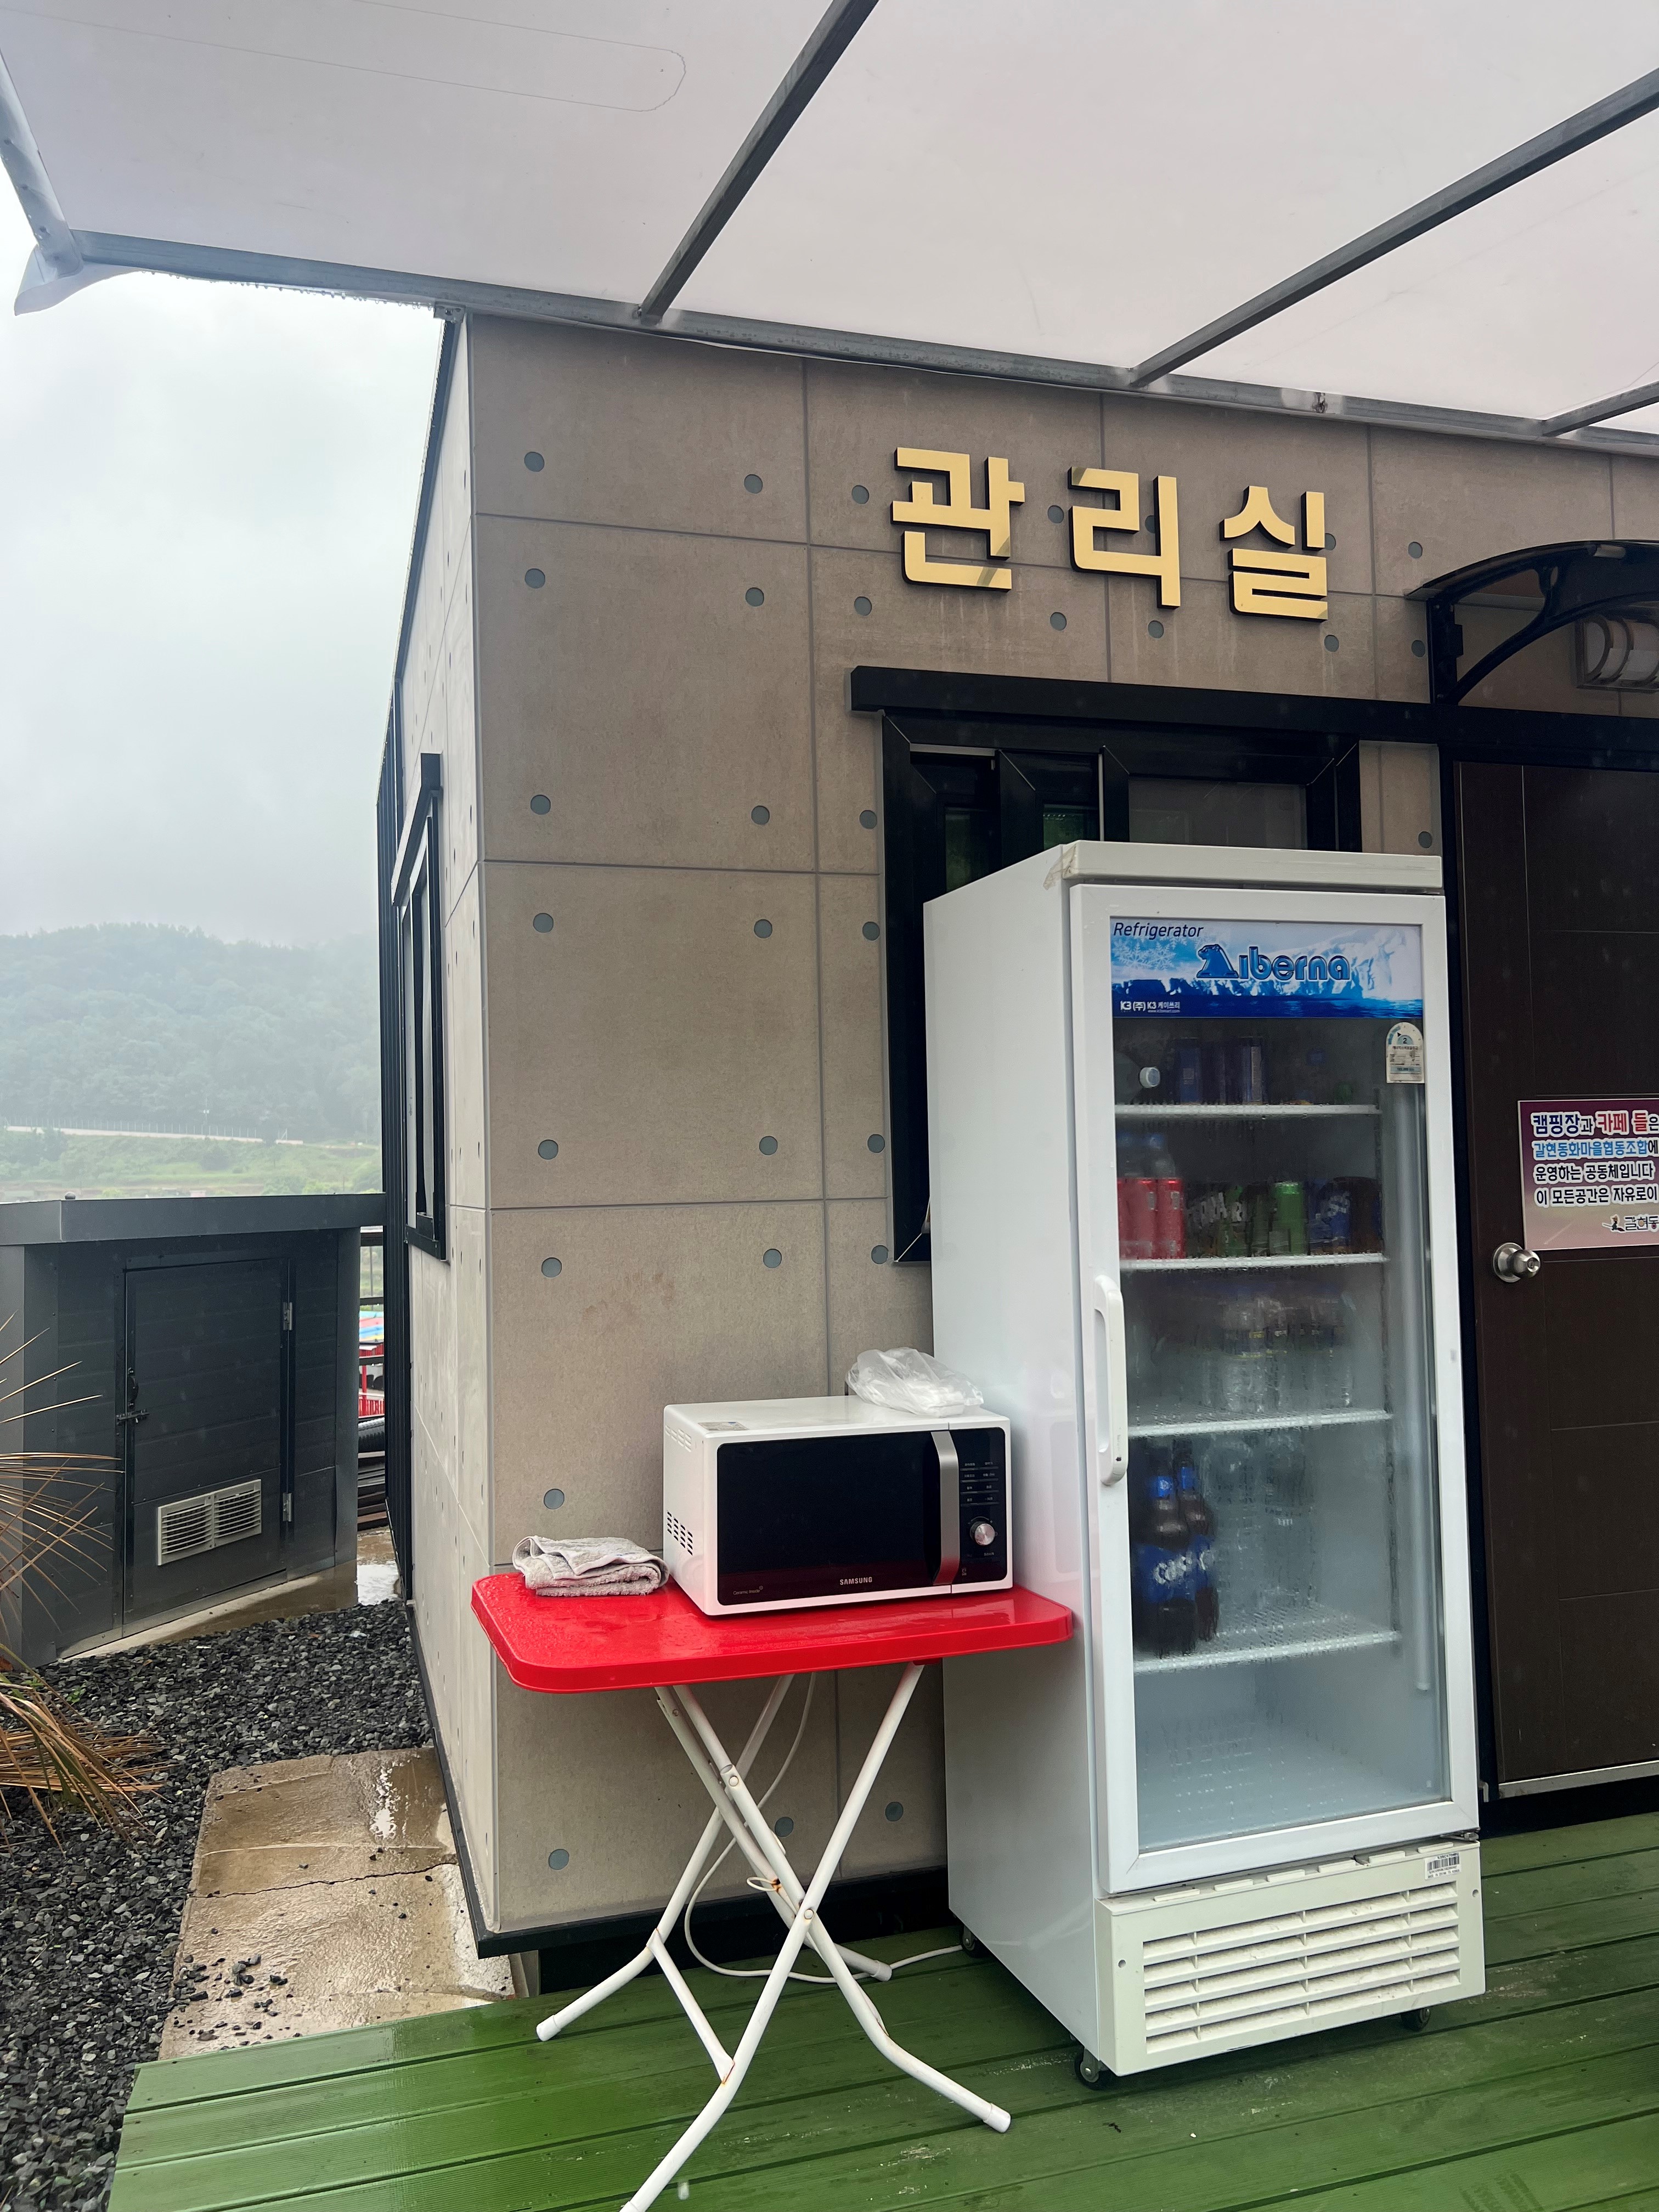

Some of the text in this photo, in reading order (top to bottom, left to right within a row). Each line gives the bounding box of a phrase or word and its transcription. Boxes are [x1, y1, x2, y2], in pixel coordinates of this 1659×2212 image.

[890, 447, 1328, 622] 관리실
[1113, 922, 1204, 940] Refrigerator
[1147, 1001, 1156, 1009] K3
[1158, 1001, 1181, 1009] 케이쓰리
[1533, 1113, 1659, 1135] 캠핑장과 카페 들은
[1534, 1139, 1658, 1158] 갈현동화마을협동조합에
[1536, 1163, 1654, 1181] 운영하는 공동체입니다
[1536, 1186, 1657, 1205] 이 모든공간은 자유로이
[839, 1576, 872, 1585] SAMSUNG
